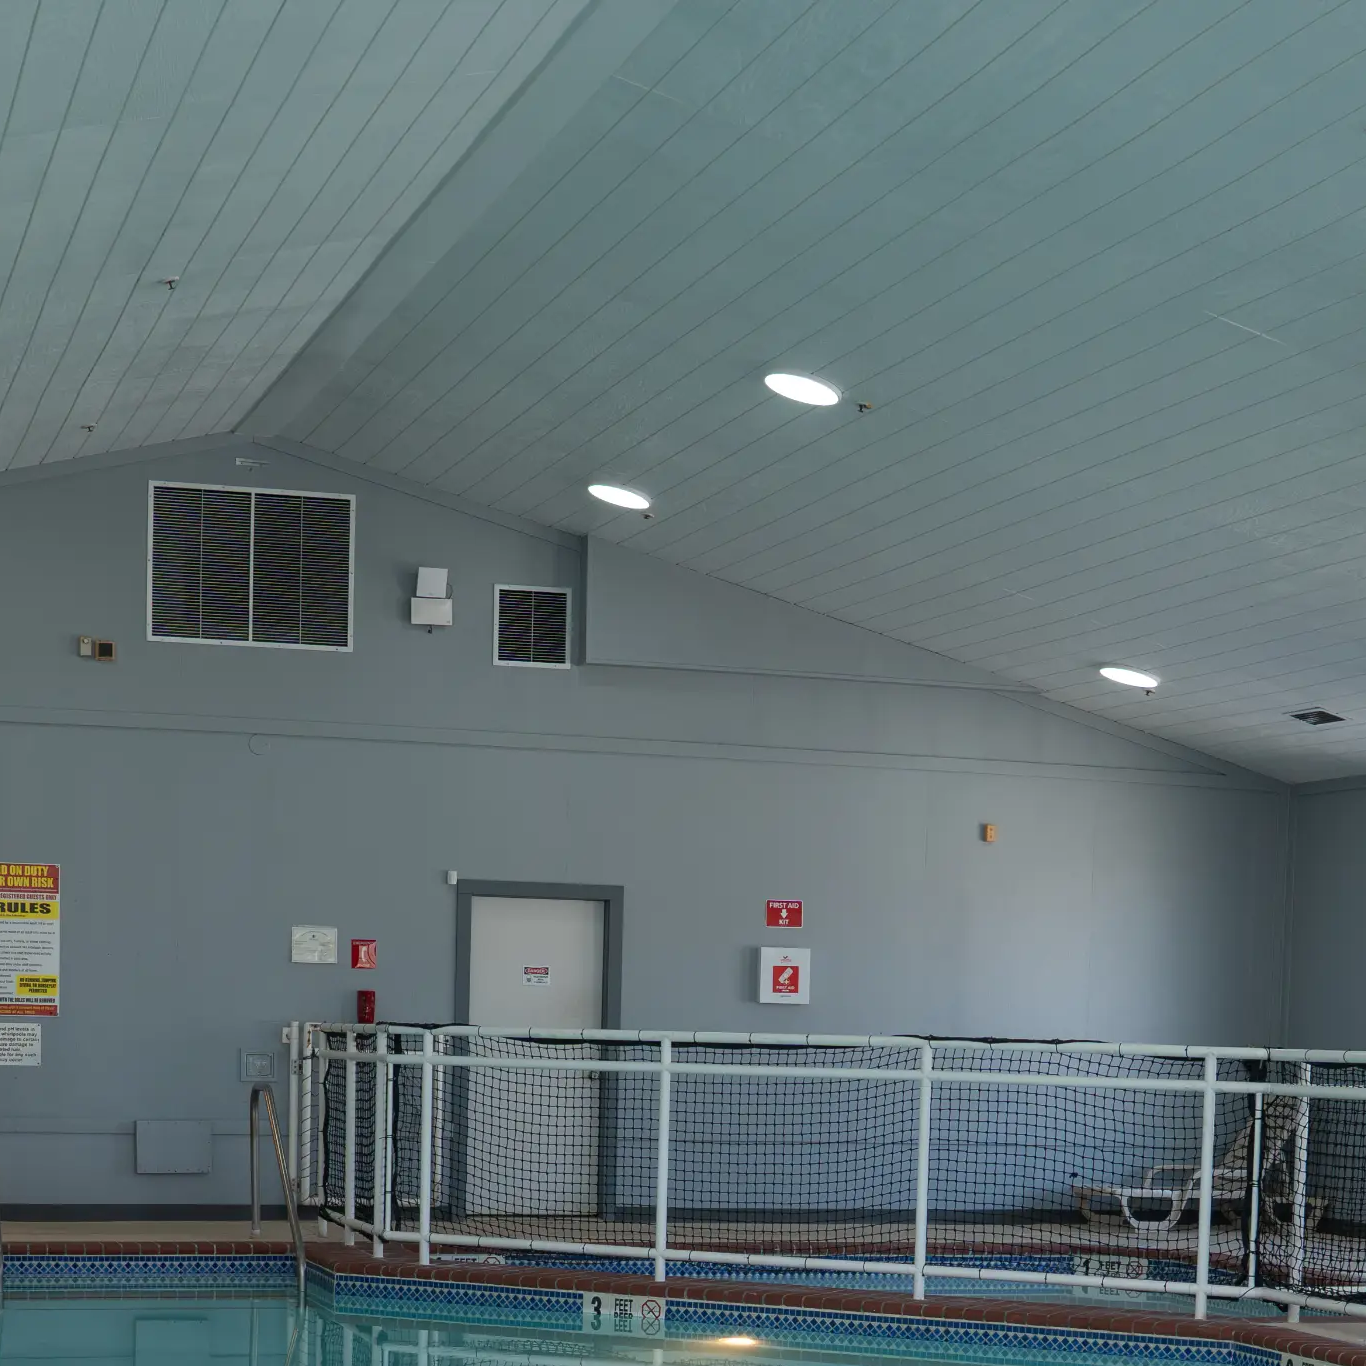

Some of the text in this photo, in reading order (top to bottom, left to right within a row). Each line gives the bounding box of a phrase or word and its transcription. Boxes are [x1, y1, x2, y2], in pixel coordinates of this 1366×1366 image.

[10, 865, 23, 875] ON
[25, 865, 48, 876] DUTY
[7, 876, 30, 887] OWN
[32, 877, 54, 888] RISK
[591, 1296, 633, 1315] 3 FEET
